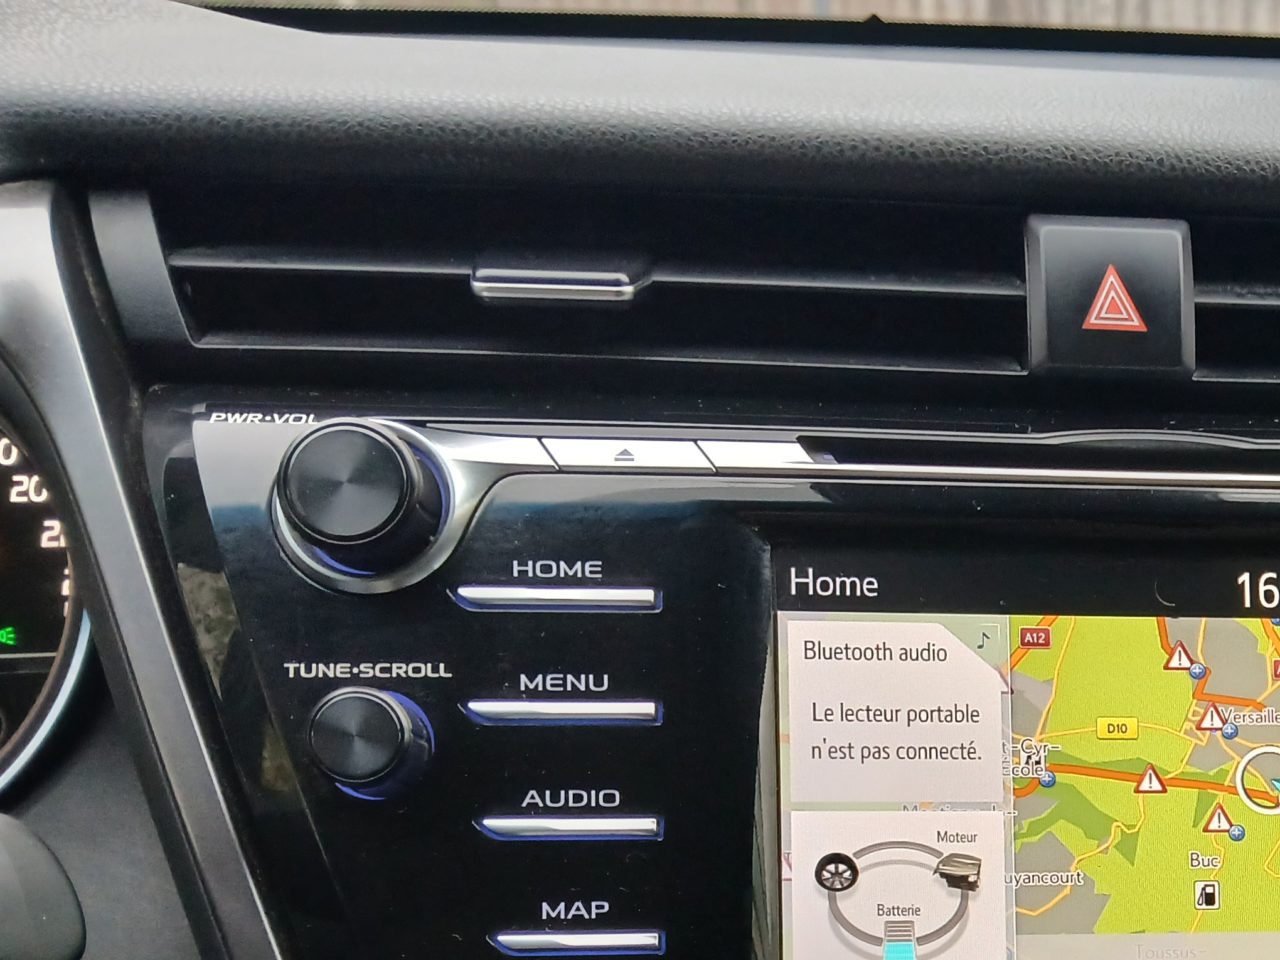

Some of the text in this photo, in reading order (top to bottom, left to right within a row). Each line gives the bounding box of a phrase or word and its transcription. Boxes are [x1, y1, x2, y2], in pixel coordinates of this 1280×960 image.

[9, 475, 48, 503] 20
[512, 560, 603, 578] HOME
[789, 567, 879, 597] Home
[1024, 633, 1046, 644] A12
[803, 640, 948, 662] Bluetooth audio
[519, 674, 609, 692] MENU
[812, 703, 980, 727] Le lecteur portable
[1107, 723, 1128, 735] D10
[811, 738, 982, 764] n'est pas connecté.
[521, 789, 621, 807] AUDIO
[936, 830, 978, 844] Moteur
[1190, 853, 1220, 868] Buc
[1004, 871, 1083, 887] uyancourt
[541, 902, 610, 920] MAP
[877, 904, 921, 917] Batterie
